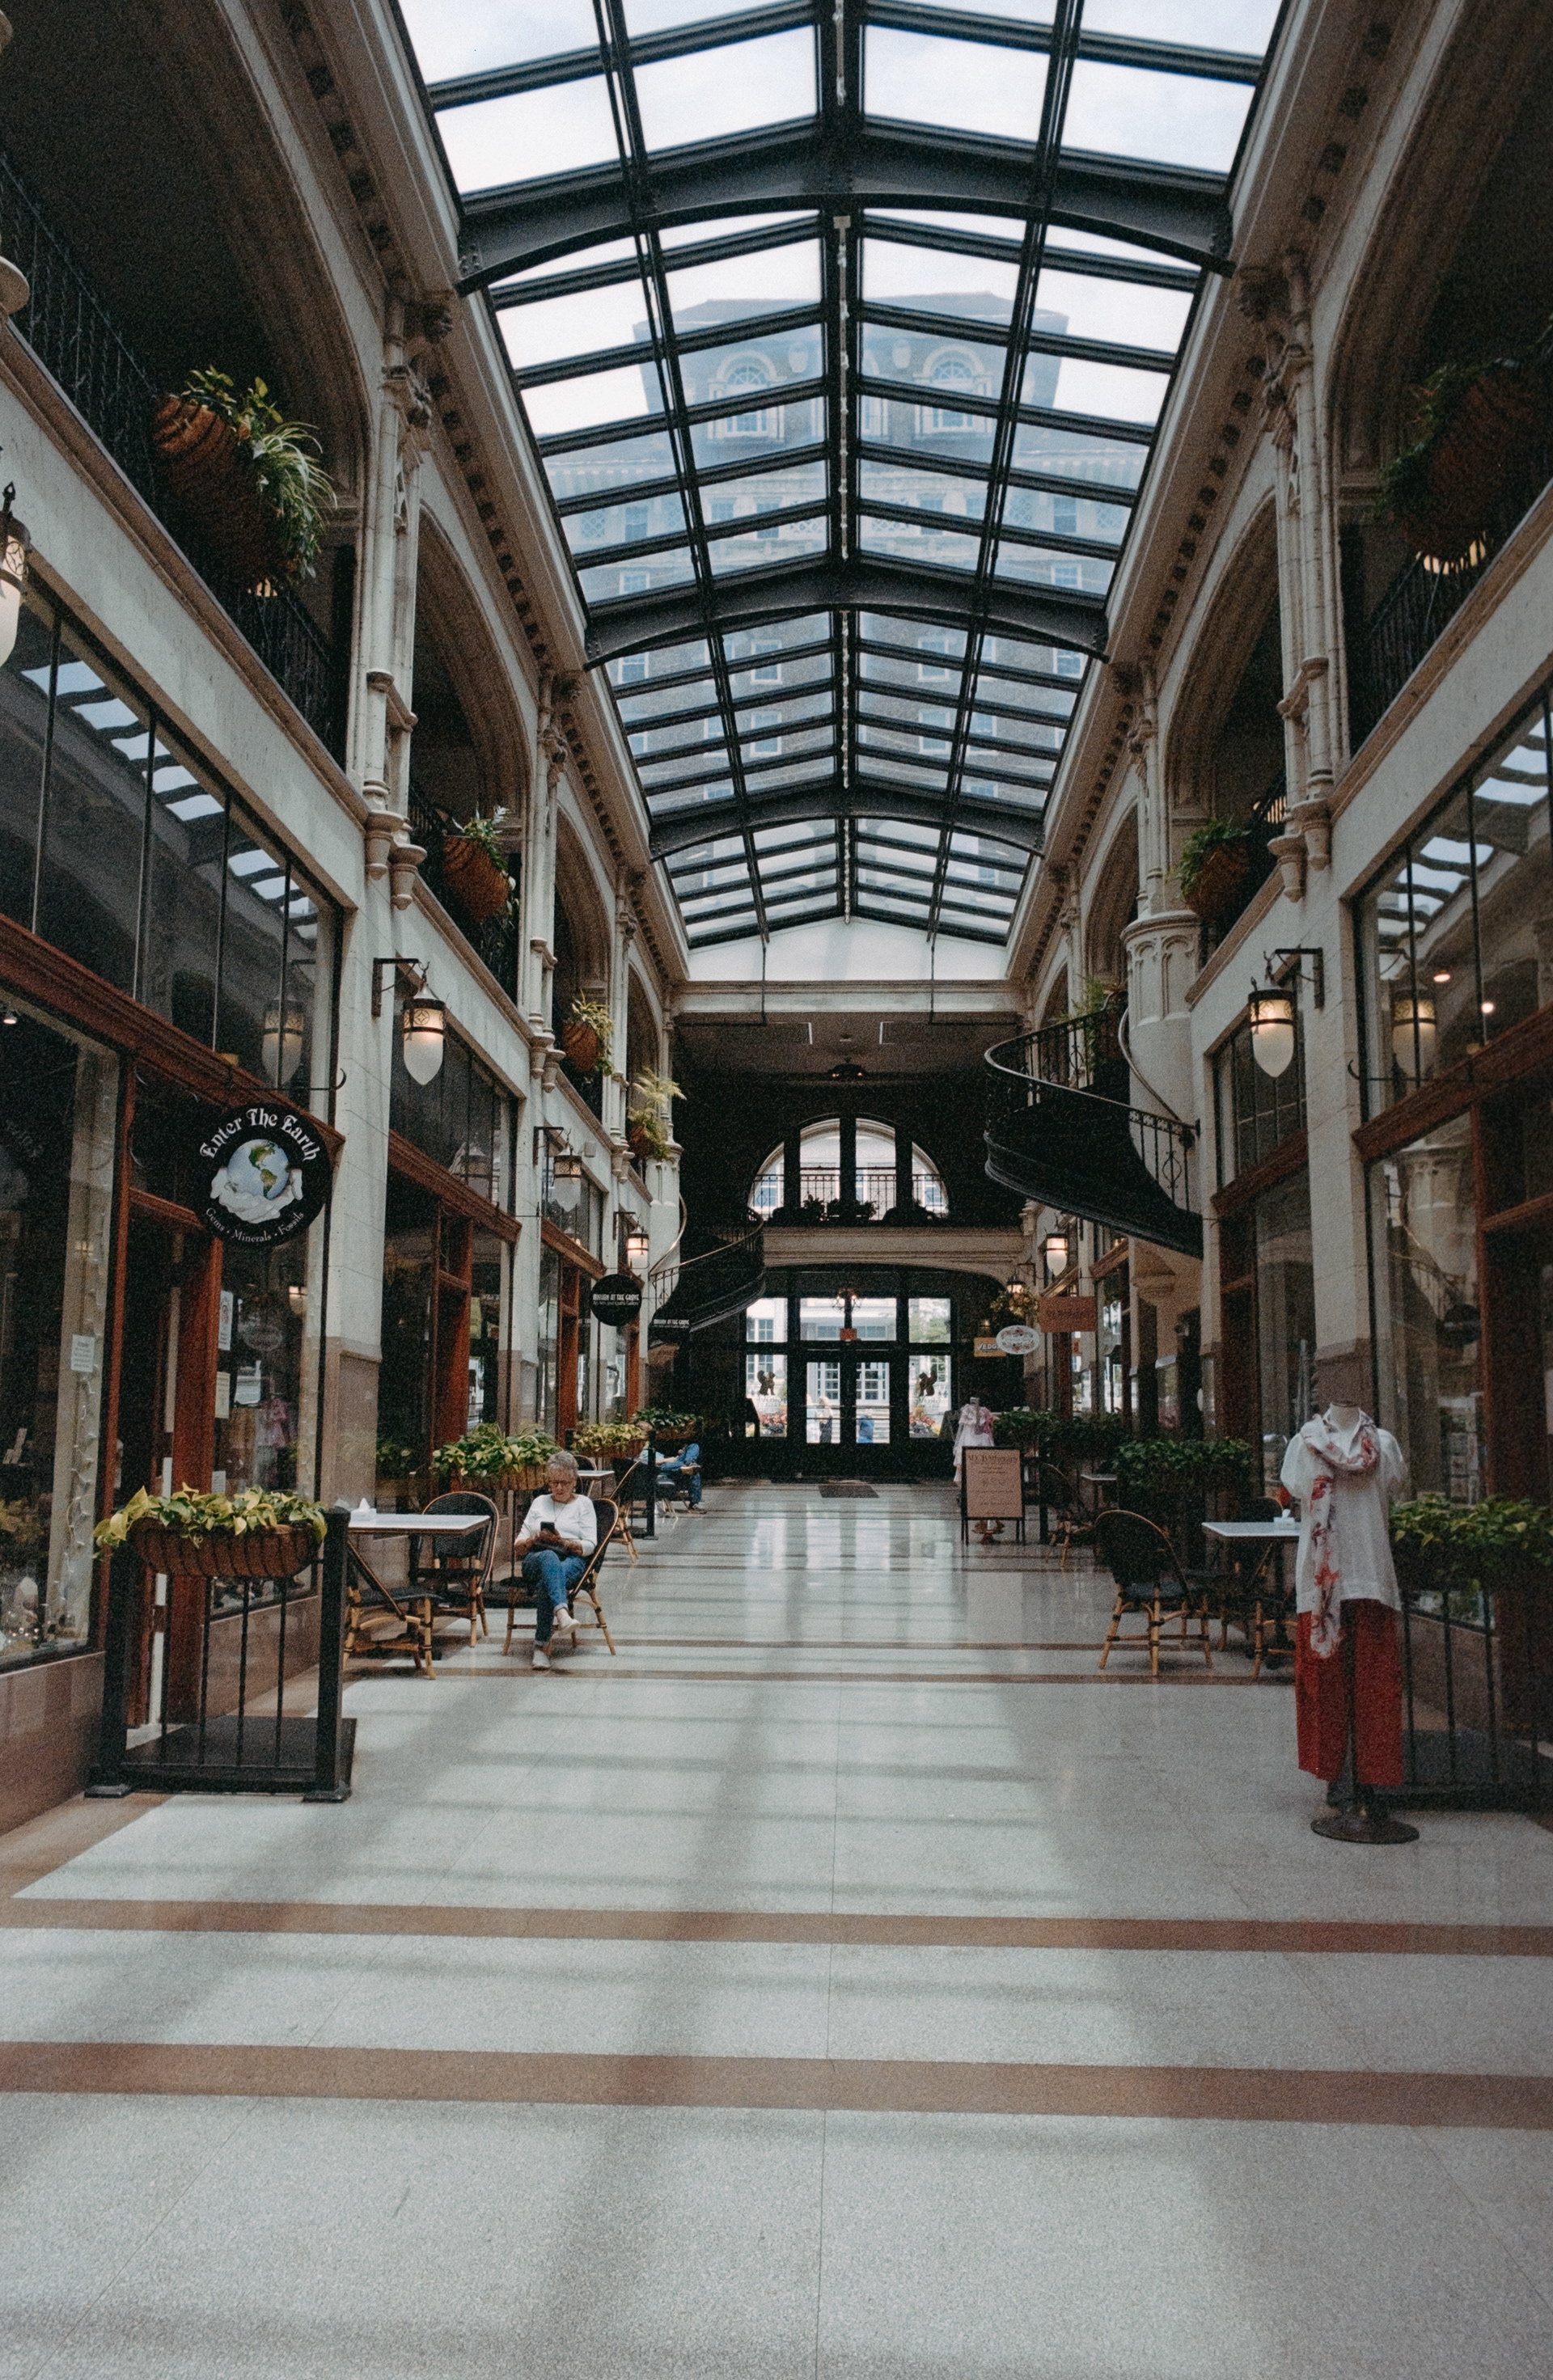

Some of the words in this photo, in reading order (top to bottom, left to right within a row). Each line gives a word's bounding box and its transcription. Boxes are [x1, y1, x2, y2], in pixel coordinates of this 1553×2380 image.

[200, 1117, 242, 1159] Enter
[246, 1108, 277, 1128] The
[281, 1114, 319, 1161] Earth
[205, 1207, 225, 1232] Gems
[231, 1229, 271, 1243] Minerals
[278, 1211, 304, 1235] Fossils
